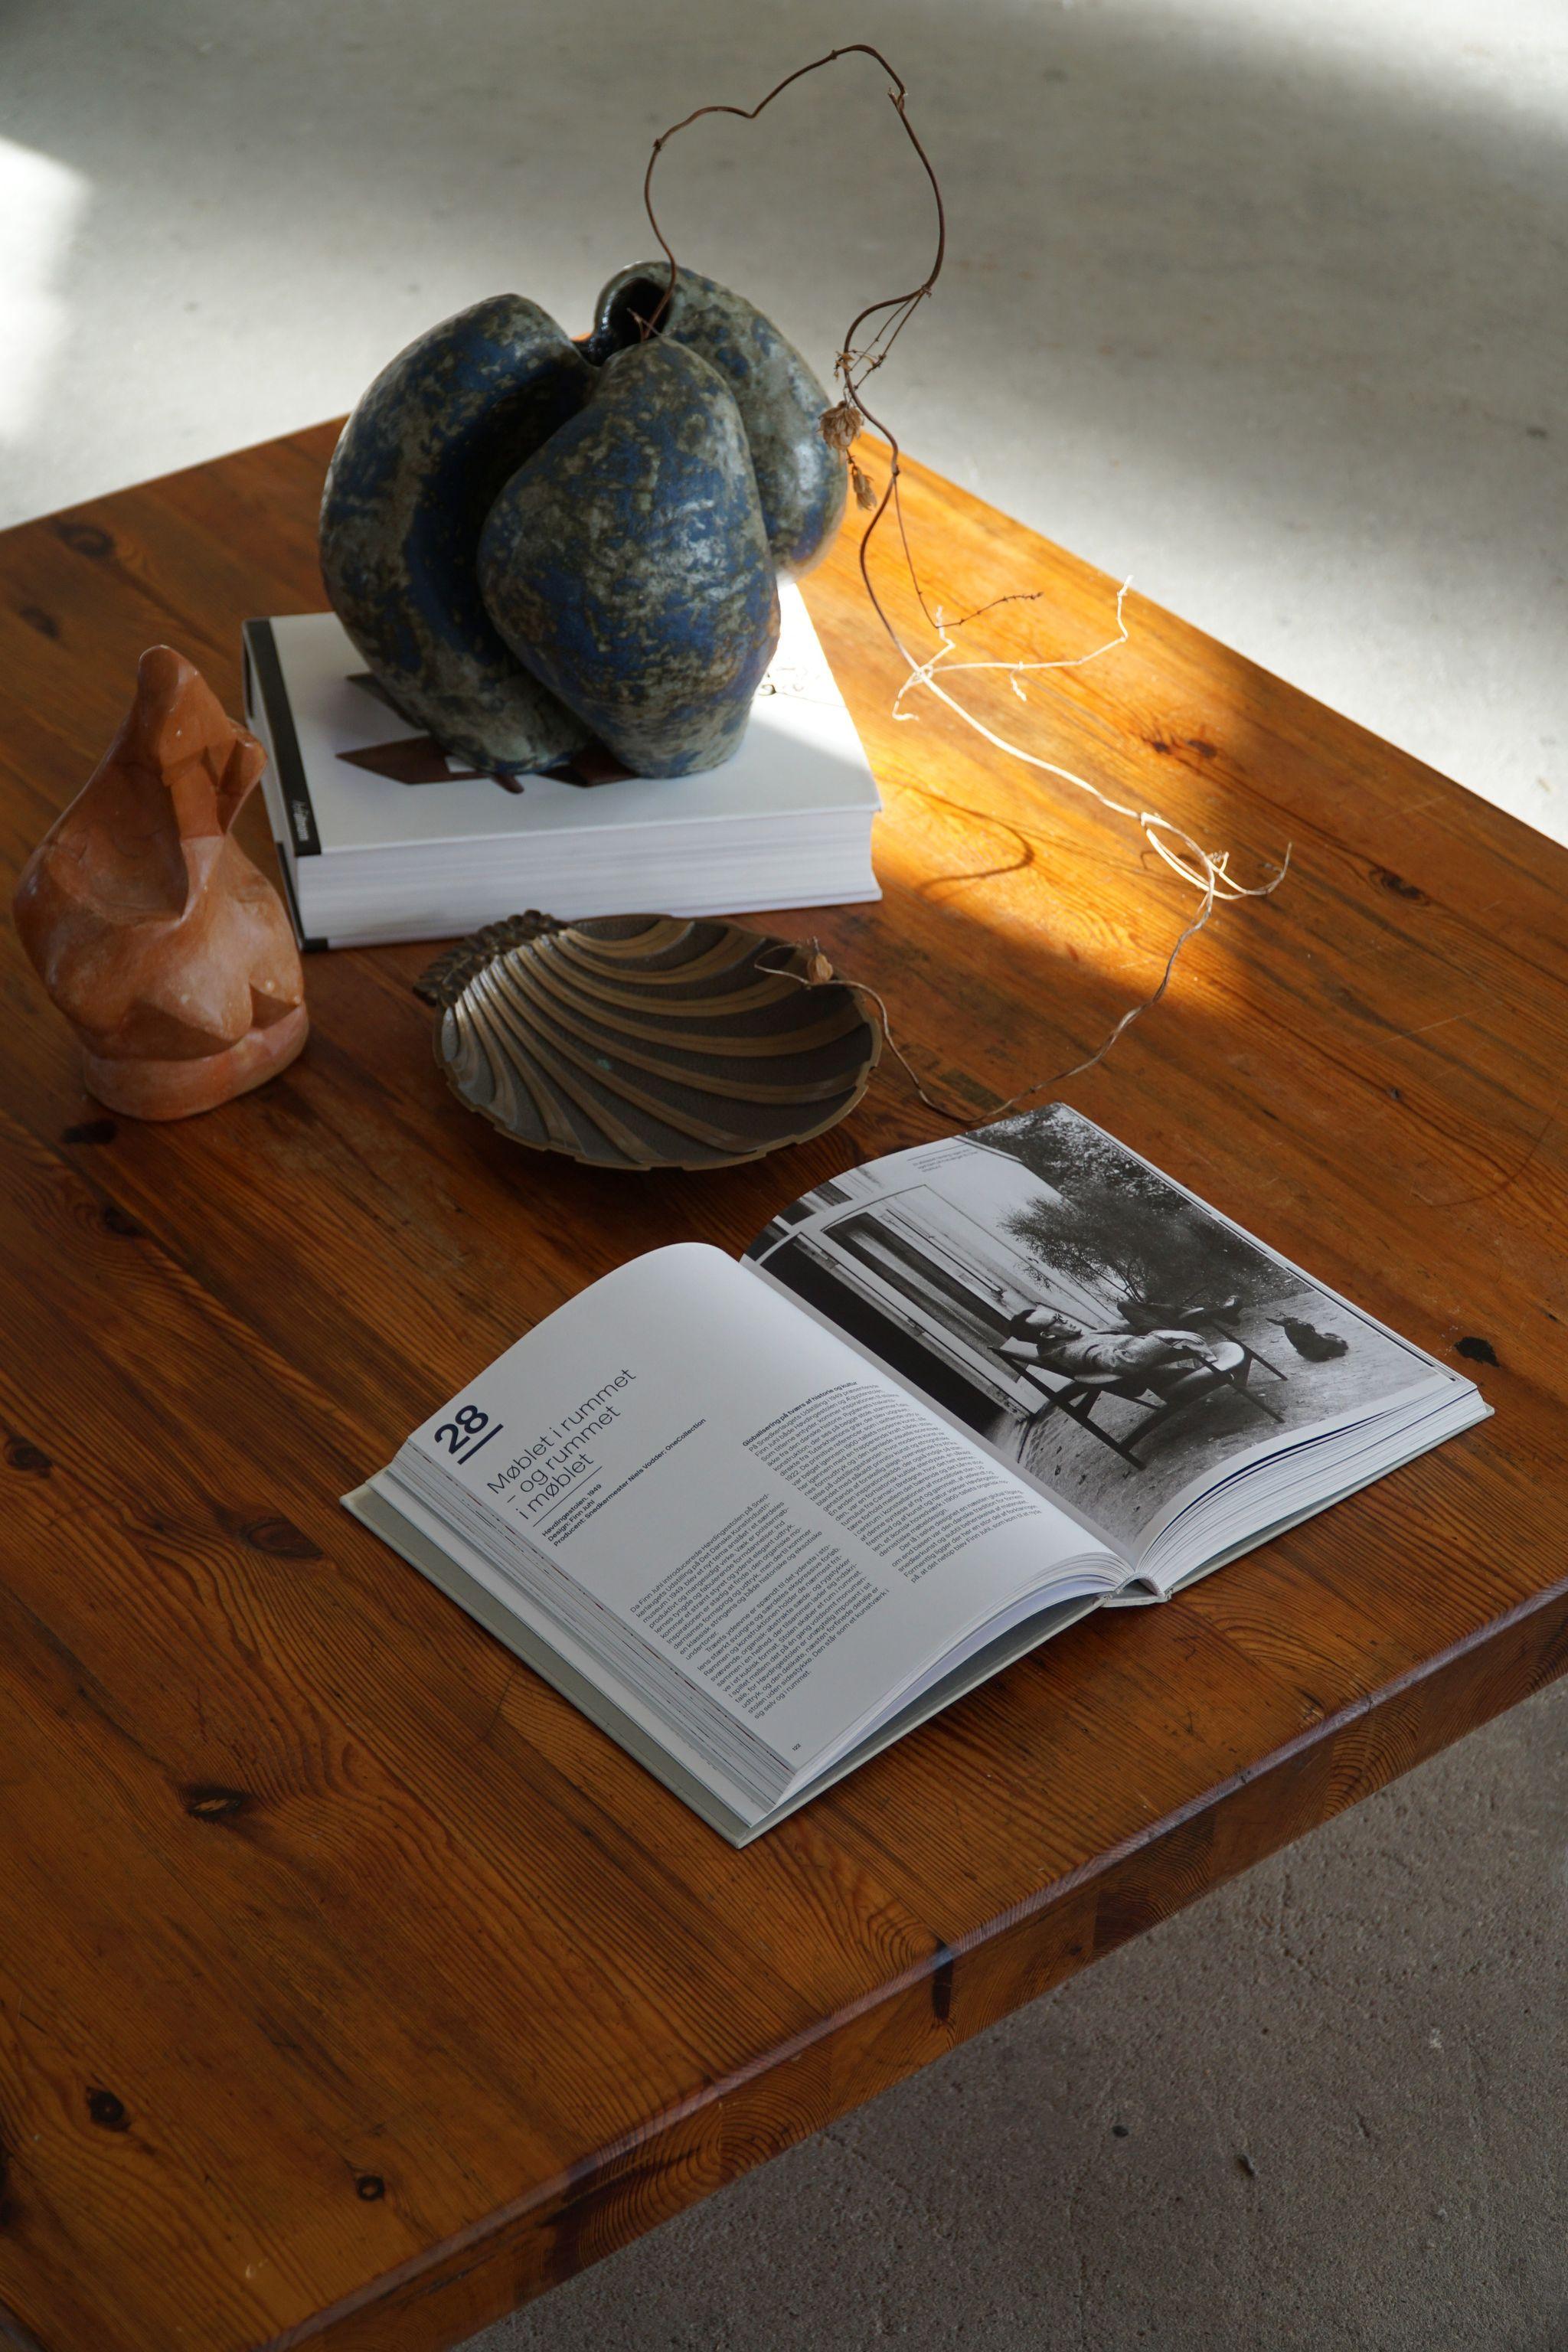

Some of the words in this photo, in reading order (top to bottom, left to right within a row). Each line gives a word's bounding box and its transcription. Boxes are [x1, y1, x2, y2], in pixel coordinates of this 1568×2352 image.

[434, 1405, 488, 1455] 28
[486, 1436, 554, 1494] Møblet
[549, 1426, 562, 1438] i
[560, 1369, 636, 1431] rummet
[520, 1468, 548, 1492] og
[545, 1406, 620, 1470] rummet
[584, 1480, 628, 1518] Snedkermester
[627, 1468, 643, 1481] Niels
[665, 1419, 706, 1450] OneCollection
[515, 1508, 528, 1519] i
[527, 1453, 593, 1512] møblet
[568, 1510, 583, 1522] Finn
[582, 1499, 595, 1511] Juhl
[586, 1484, 601, 1496] 1949
[629, 1604, 640, 1612] Da
[638, 1592, 652, 1606] Finn
[651, 1582, 664, 1593] Juhl
[662, 1550, 702, 1584] introducerede
[701, 1513, 745, 1550] Høvdingestolen
[743, 1506, 753, 1515] på
[751, 1494, 769, 1508] Sned-
[635, 1590, 666, 1617] kerlaugets
[665, 1568, 693, 1592] Udstilling
[691, 1560, 700, 1570] på
[698, 1552, 711, 1563] Det
[709, 1534, 732, 1553] Danske
[730, 1502, 769, 1536] Kunstindustri-
[642, 1600, 668, 1623] museum
[683, 1574, 697, 1586] blev
[703, 1560, 714, 1570] nyt
[711, 1548, 728, 1561] tema
[648, 1601, 678, 1629] produktivt
[677, 1594, 687, 1602] og
[684, 1564, 720, 1596] mangesidigt
[733, 1540, 749, 1552] Væk
[754, 1508, 789, 1537] polstermøb-
[654, 1616, 673, 1633] lernes
[671, 1599, 693, 1617] tyngde
[692, 1590, 702, 1599] og
[699, 1563, 734, 1592] fabulerende
[773, 1520, 785, 1530] Ind
[659, 1616, 684, 1638] kommer
[691, 1594, 710, 1612] stramt
[709, 1579, 727, 1596] styret
[726, 1573, 736, 1581] og
[733, 1555, 753, 1575] yderst
[753, 1539, 774, 1558] elegant
[666, 1611, 704, 1644] Inspirationen
[709, 1589, 729, 1606] stadig
[733, 1571, 749, 1585] finde
[750, 1560, 763, 1570] den
[762, 1537, 790, 1560] organiske
[789, 1527, 801, 1537] mo-
[673, 1622, 703, 1649] dernismes
[701, 1595, 733, 1623] formsprog
[760, 1561, 773, 1573] men
[773, 1547, 789, 1562] dertil
[786, 1529, 811, 1549] kommer
[679, 1646, 688, 1655] en
[686, 1626, 710, 1648] klassisk
[710, 1603, 737, 1627] stringens
[737, 1596, 746, 1604] og
[743, 1583, 760, 1597] både
[758, 1560, 787, 1583] historiske
[794, 1530, 822, 1553] eksotiske
[697, 1659, 711, 1671] lens
[710, 1642, 730, 1660] stærkt
[730, 1620, 754, 1642] svungne
[753, 1612, 763, 1621] og
[788, 1561, 822, 1591] ekspressive
[703, 1653, 730, 1676] Rammen
[736, 1609, 780, 1647] konstruktionen
[777, 1592, 797, 1609] holder
[805, 1563, 831, 1586] nærmest
[740, 1607, 794, 1655] organisk-abstrakte
[819, 1558, 850, 1585] rygstykker
[770, 1673, 782, 1684] den
[852, 1592, 872, 1610] detalje
[792, 1743, 802, 1751] 122
